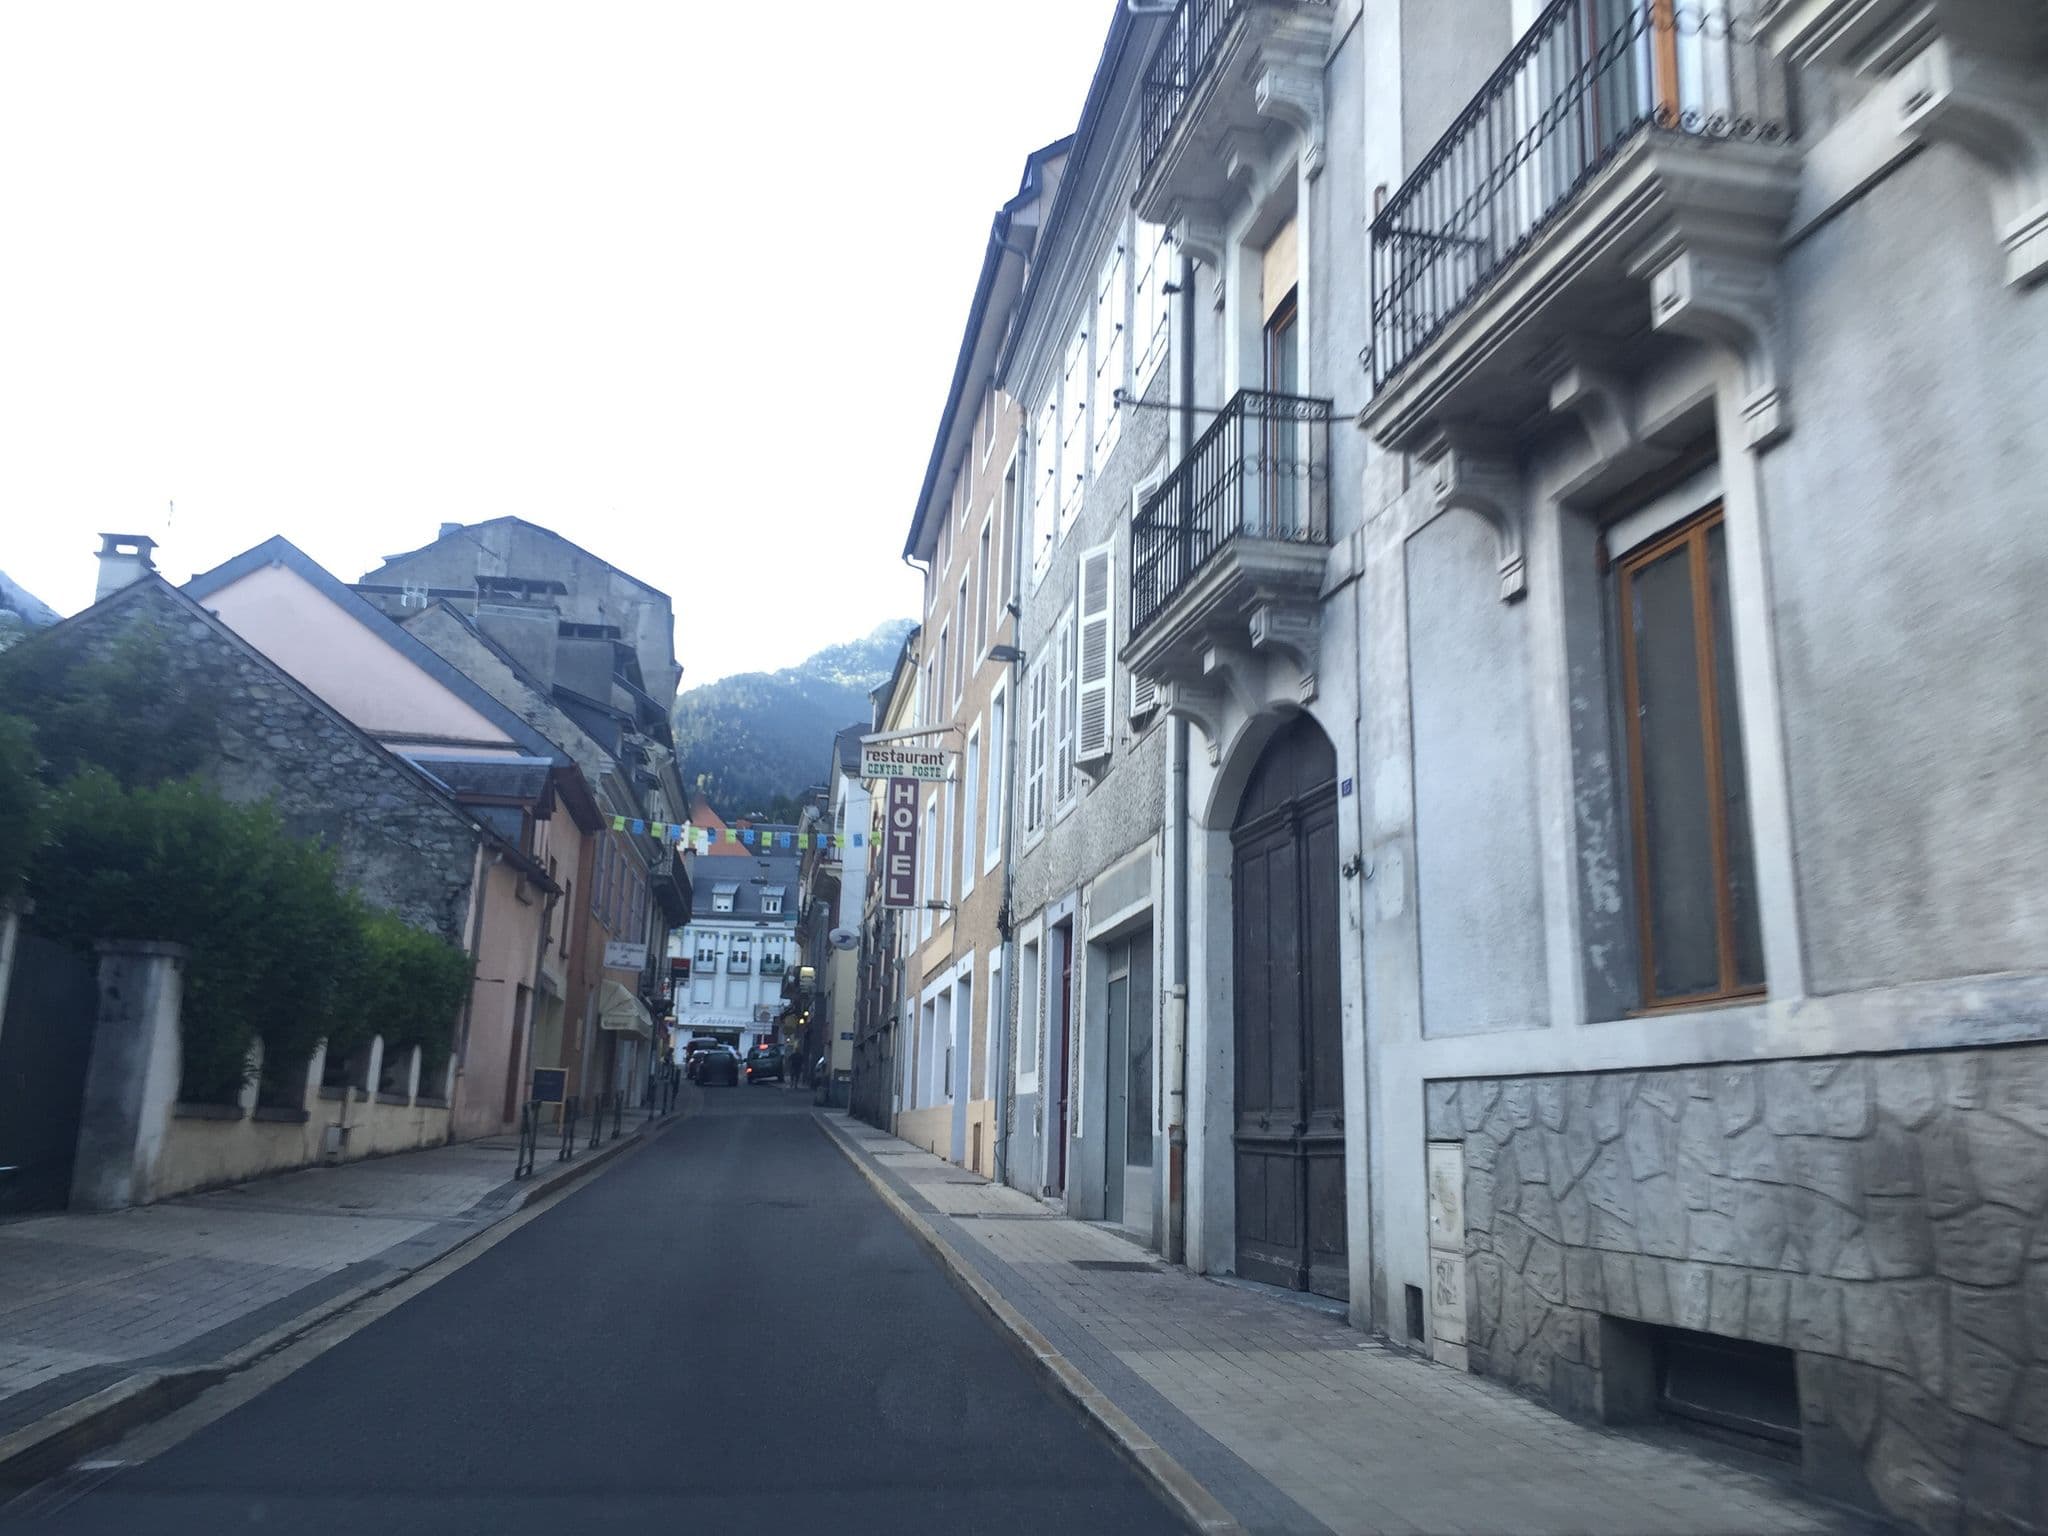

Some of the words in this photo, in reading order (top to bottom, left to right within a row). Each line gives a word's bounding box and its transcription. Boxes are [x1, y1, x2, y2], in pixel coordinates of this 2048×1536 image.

[866, 749, 944, 766] restaurant
[867, 763, 904, 776] CENTRE
[912, 766, 942, 778] POSTE
[890, 784, 914, 899] HOTEL
